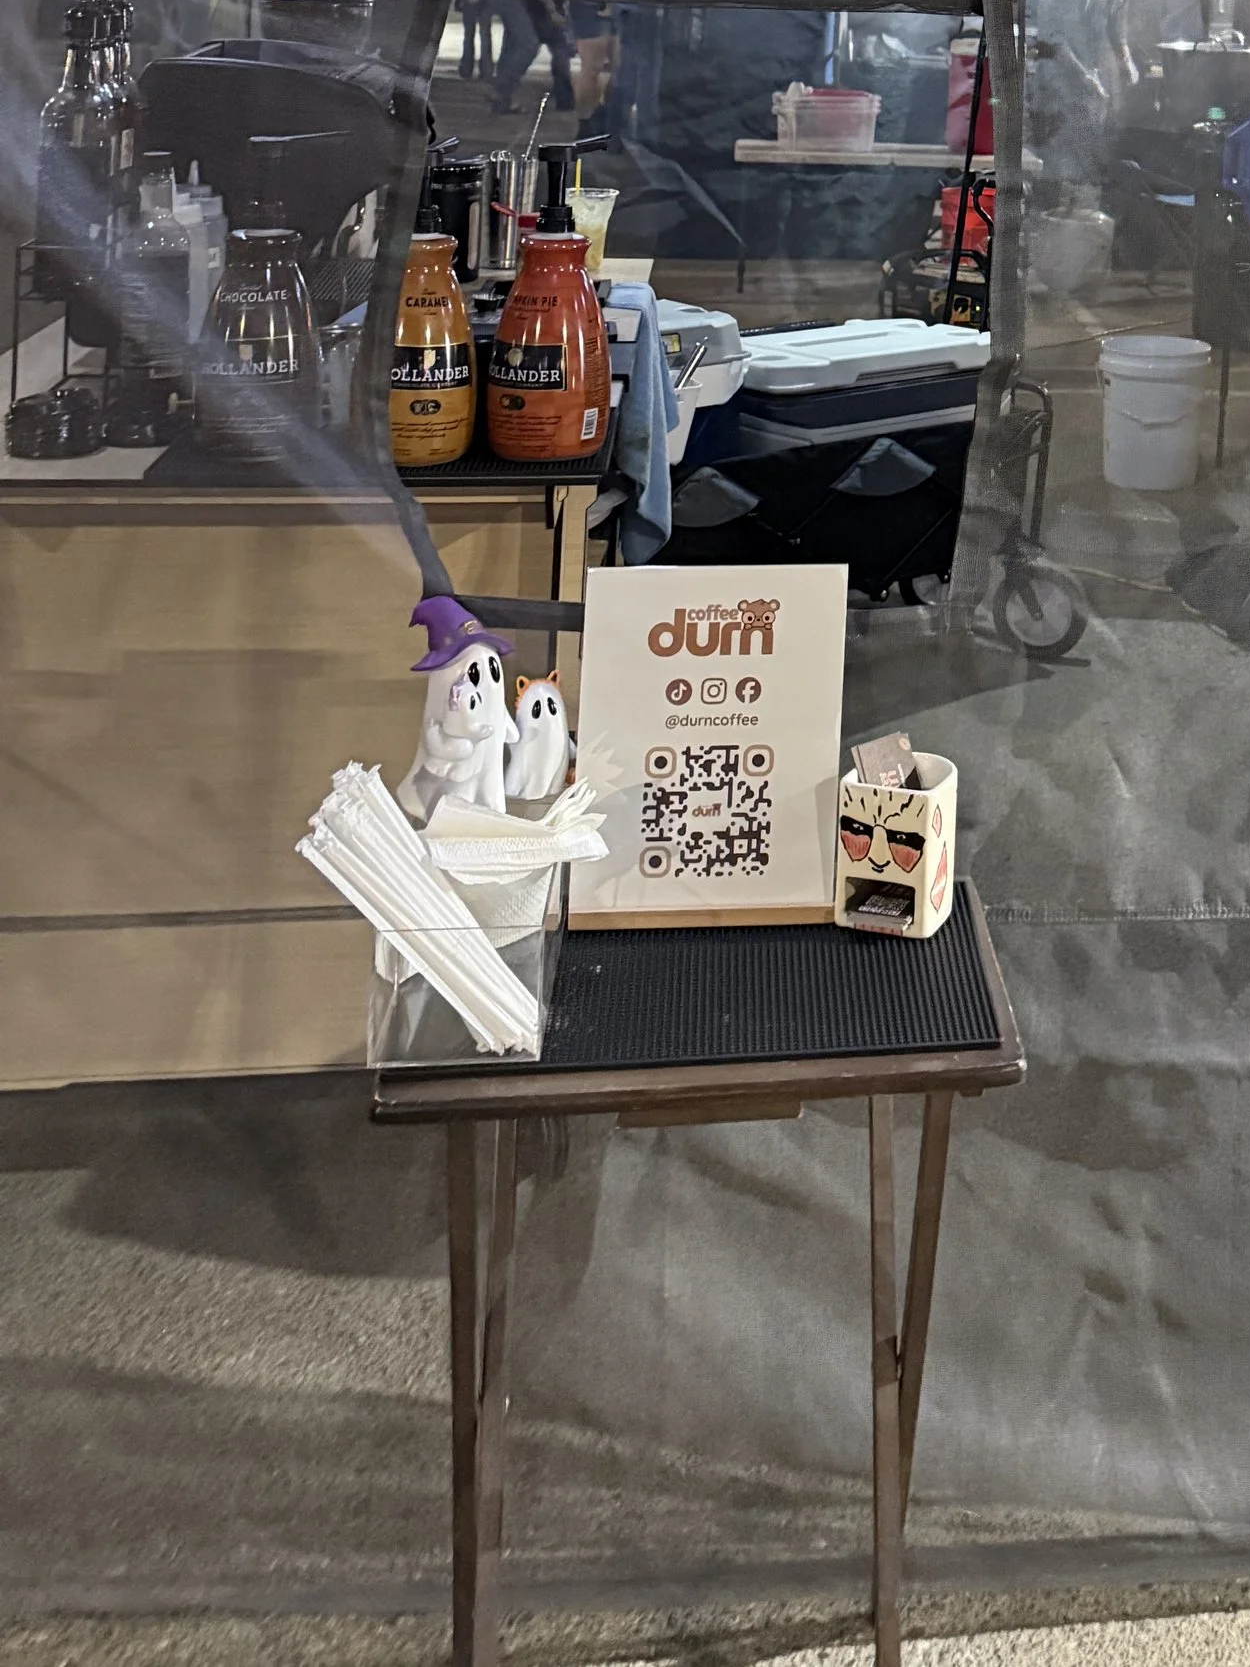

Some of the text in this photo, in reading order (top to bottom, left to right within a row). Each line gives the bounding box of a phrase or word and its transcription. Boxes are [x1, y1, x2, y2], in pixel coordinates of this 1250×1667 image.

[220, 289, 288, 303] CHOCOLATE
[541, 295, 558, 307] PIE
[390, 365, 470, 382] OLLANDER
[488, 364, 561, 383] OLLANDER
[687, 604, 739, 622] coffee
[647, 608, 774, 657] durn
[665, 712, 759, 730] @durncoffee
